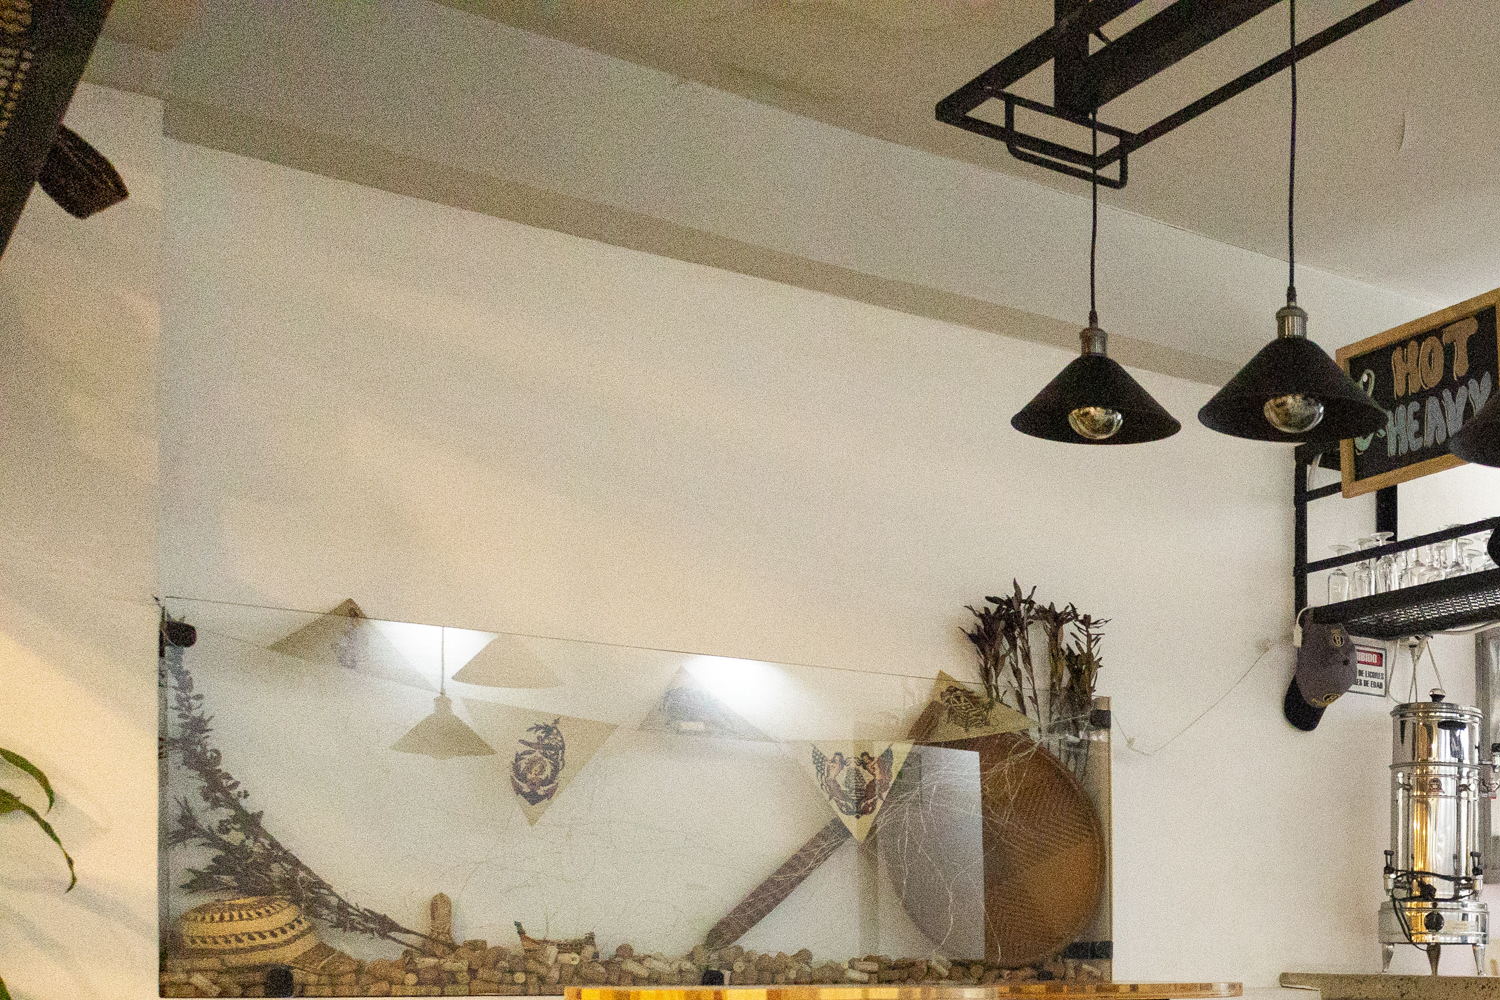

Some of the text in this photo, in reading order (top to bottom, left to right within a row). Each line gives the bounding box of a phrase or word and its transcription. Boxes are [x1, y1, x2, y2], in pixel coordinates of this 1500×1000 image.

[1391, 317, 1479, 401] HOT
[1386, 371, 1492, 458] HEAVY
[1365, 670, 1385, 681] LICORES
[1370, 680, 1384, 690] EDAD
